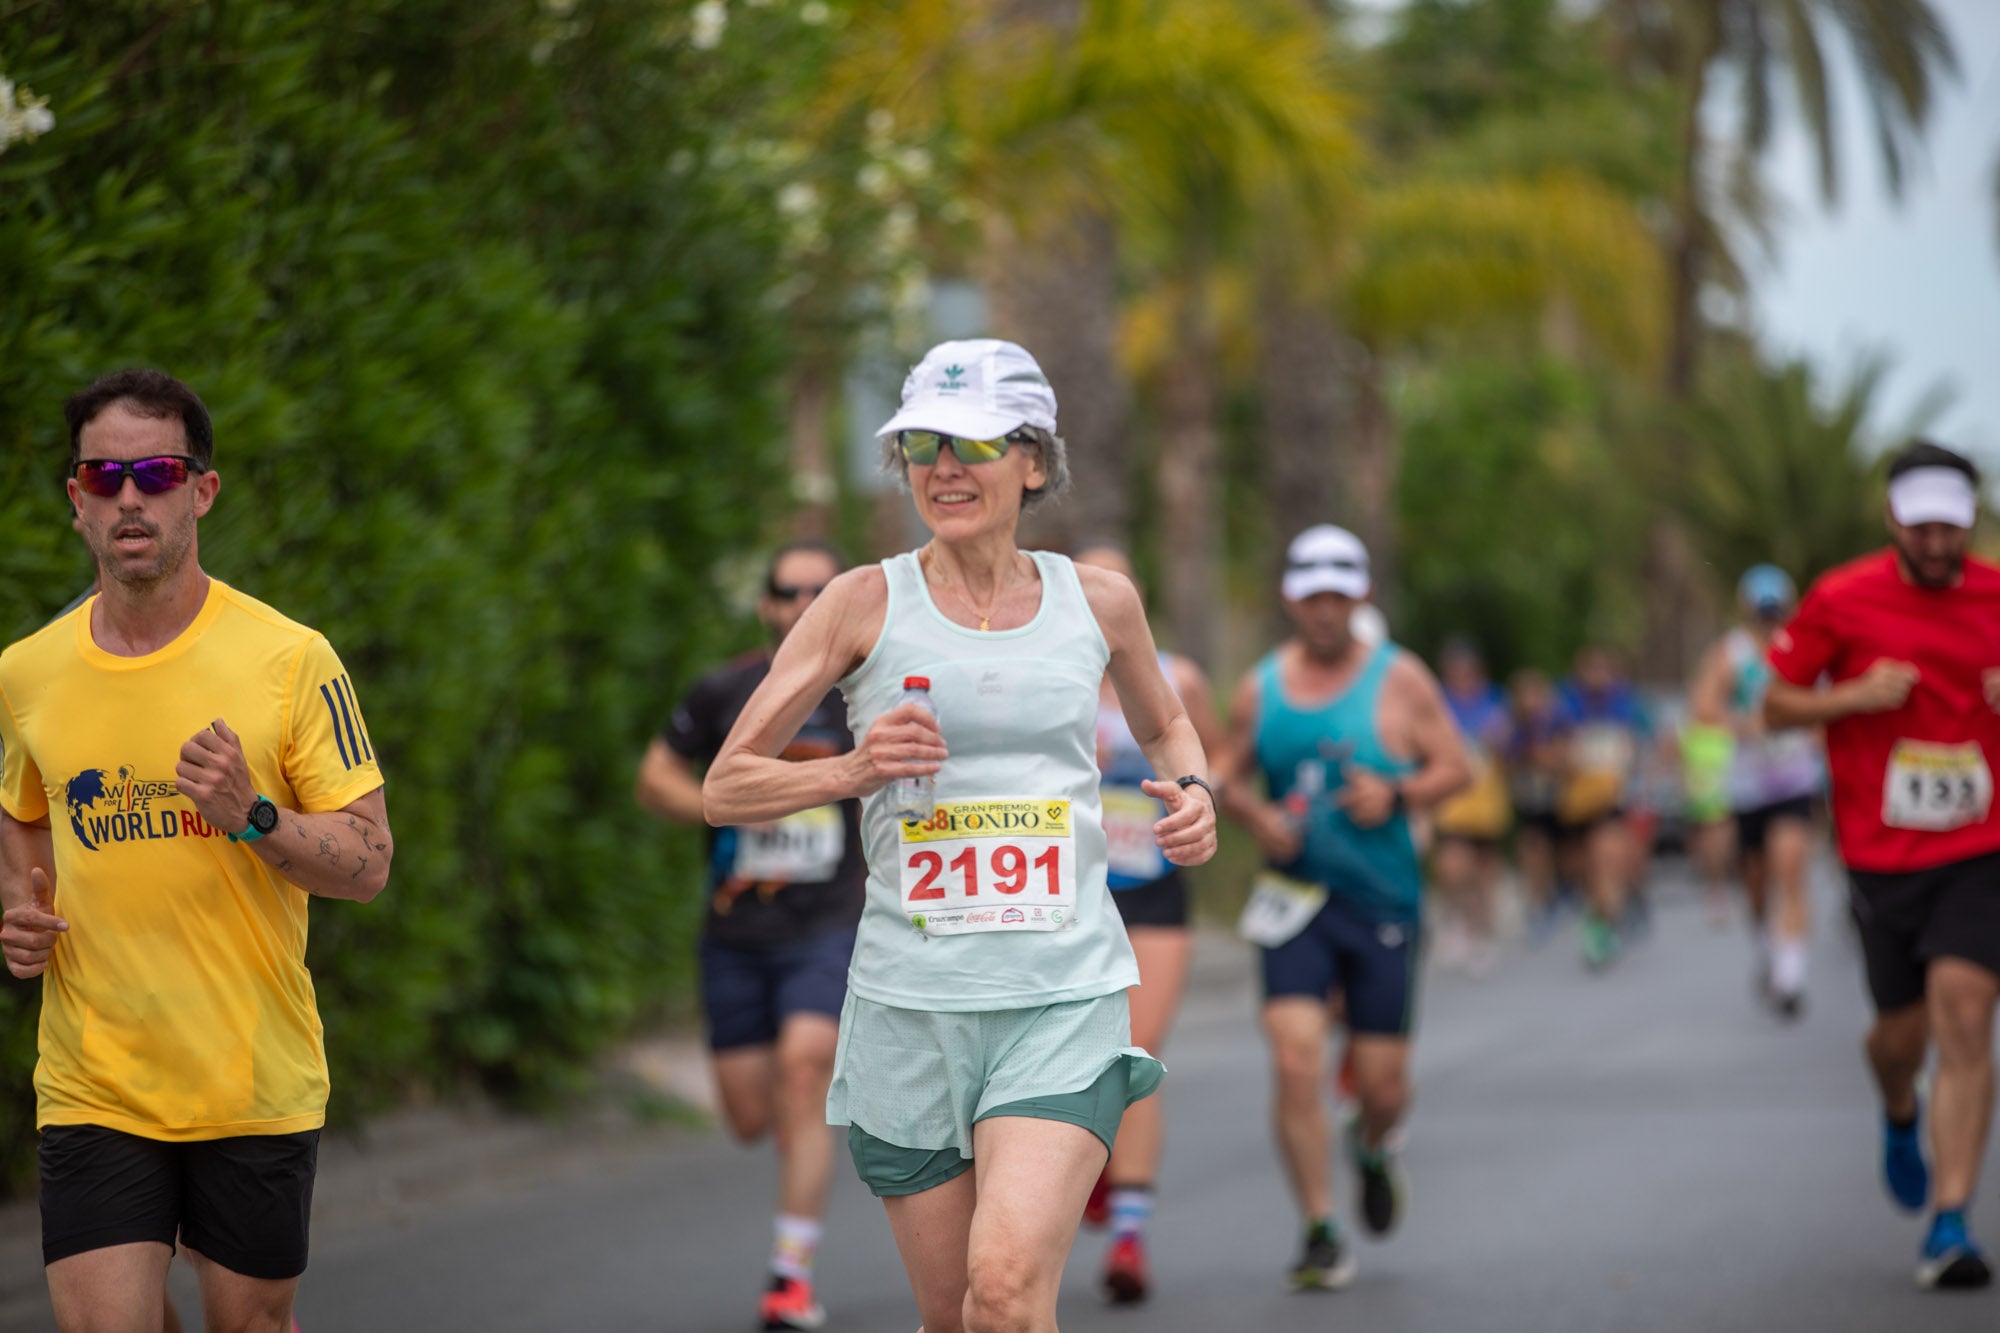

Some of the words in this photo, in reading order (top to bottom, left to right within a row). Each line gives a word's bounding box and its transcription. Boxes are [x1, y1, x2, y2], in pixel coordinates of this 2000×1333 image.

[104, 781, 168, 799] WINGS
[103, 799, 117, 807] FOR
[117, 797, 152, 813] LIFE
[953, 805, 986, 814] GRAN
[989, 803, 1030, 812] PREMIO
[88, 810, 178, 844] WORLD
[950, 812, 1039, 832] FONDO
[907, 845, 1060, 902] 2191
